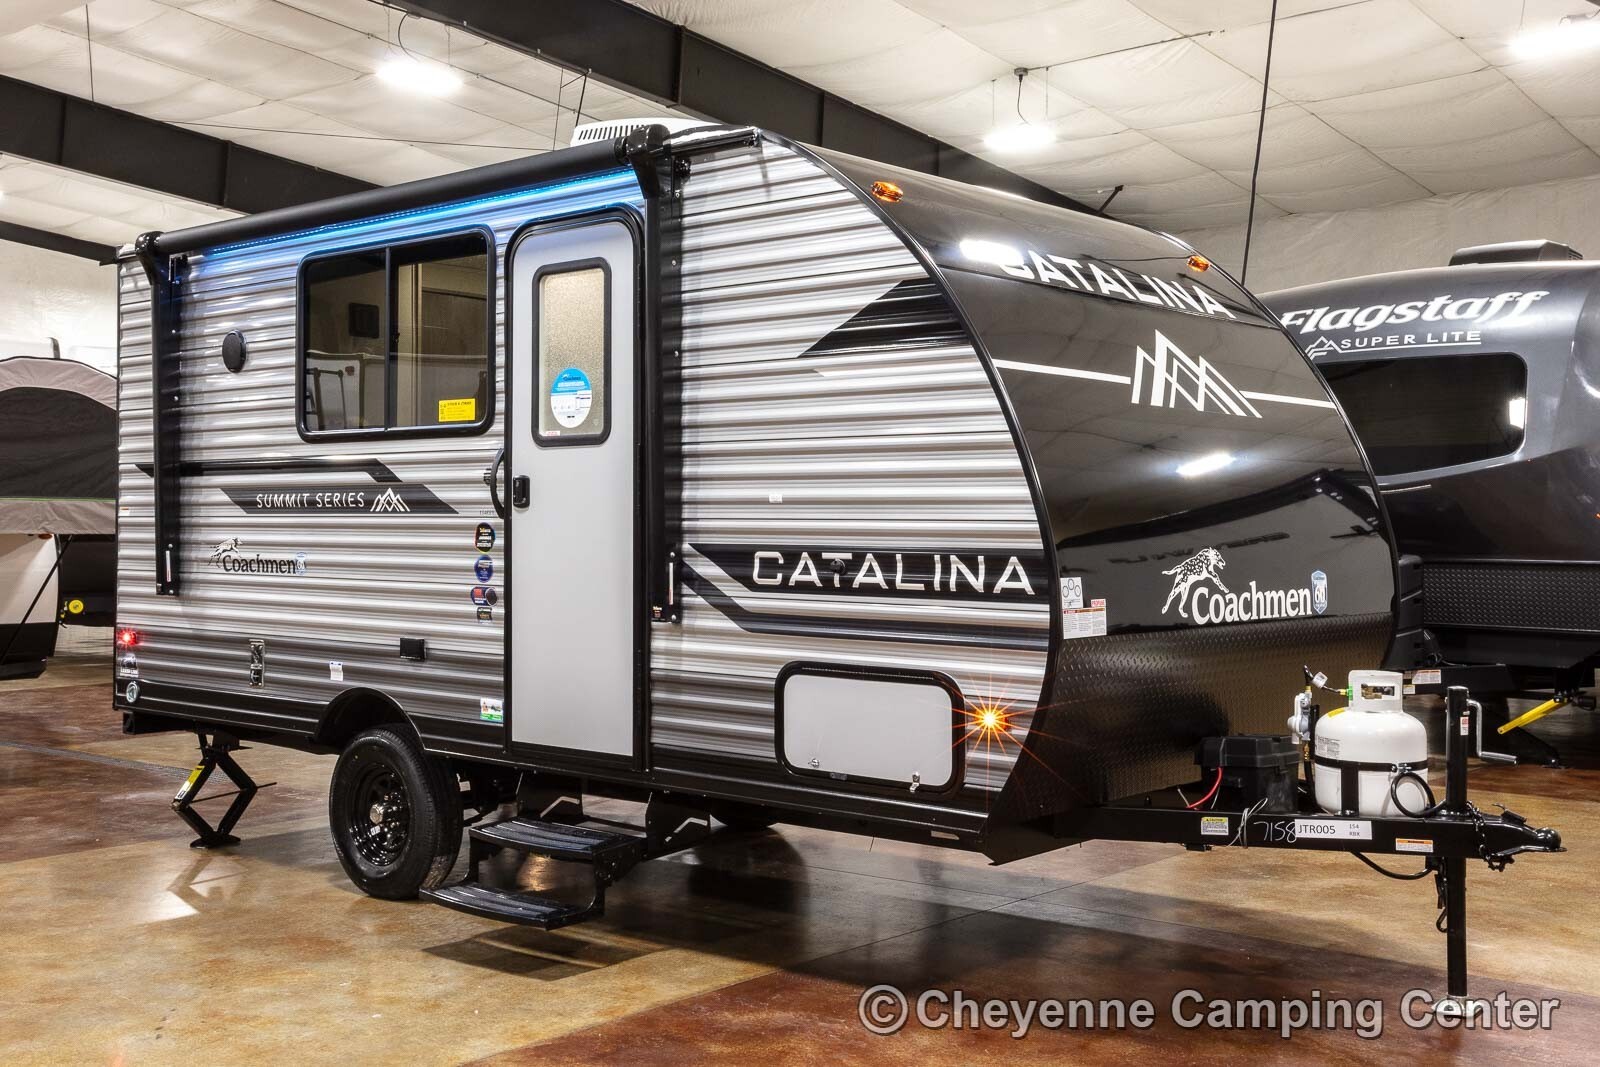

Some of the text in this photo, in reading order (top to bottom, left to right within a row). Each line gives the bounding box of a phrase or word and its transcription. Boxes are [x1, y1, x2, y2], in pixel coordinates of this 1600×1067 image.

[1281, 290, 1550, 335] Flagstaff
[1340, 330, 1482, 349] SUPER LITE
[256, 492, 365, 508] SUMMIT SERIES
[222, 554, 296, 574] Coachmen
[752, 551, 1036, 596] CATALINA
[1191, 580, 1312, 625] Coachmen
[1298, 824, 1336, 835] JTR005
